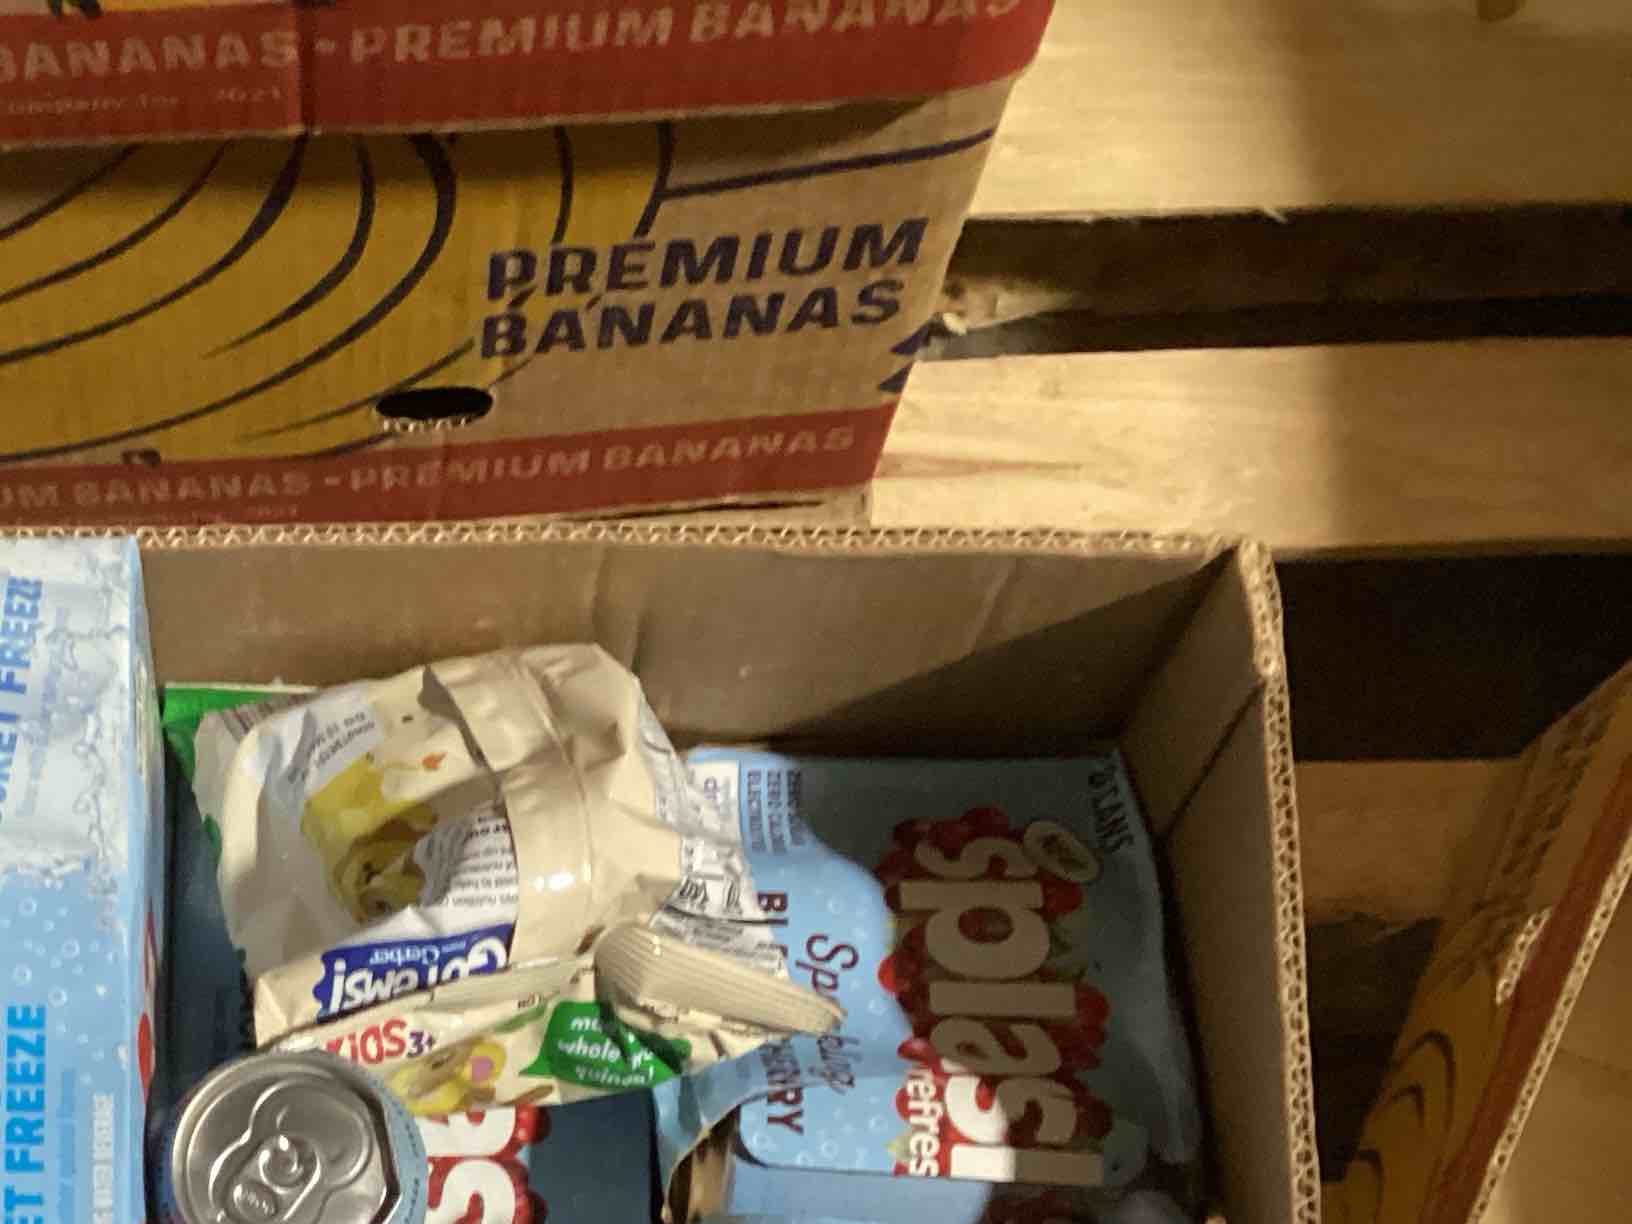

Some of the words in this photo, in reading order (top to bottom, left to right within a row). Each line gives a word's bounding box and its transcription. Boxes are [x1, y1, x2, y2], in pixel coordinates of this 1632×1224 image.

[349, 7, 676, 64] PREMIUM
[486, 218, 929, 301] PREMIUM
[480, 278, 905, 359] BANANAS
[72, 469, 312, 507] BANANAS
[350, 448, 590, 494] PREMIUM
[602, 424, 858, 472] BANANAS
[4, 1005, 48, 1172] FREEZE
